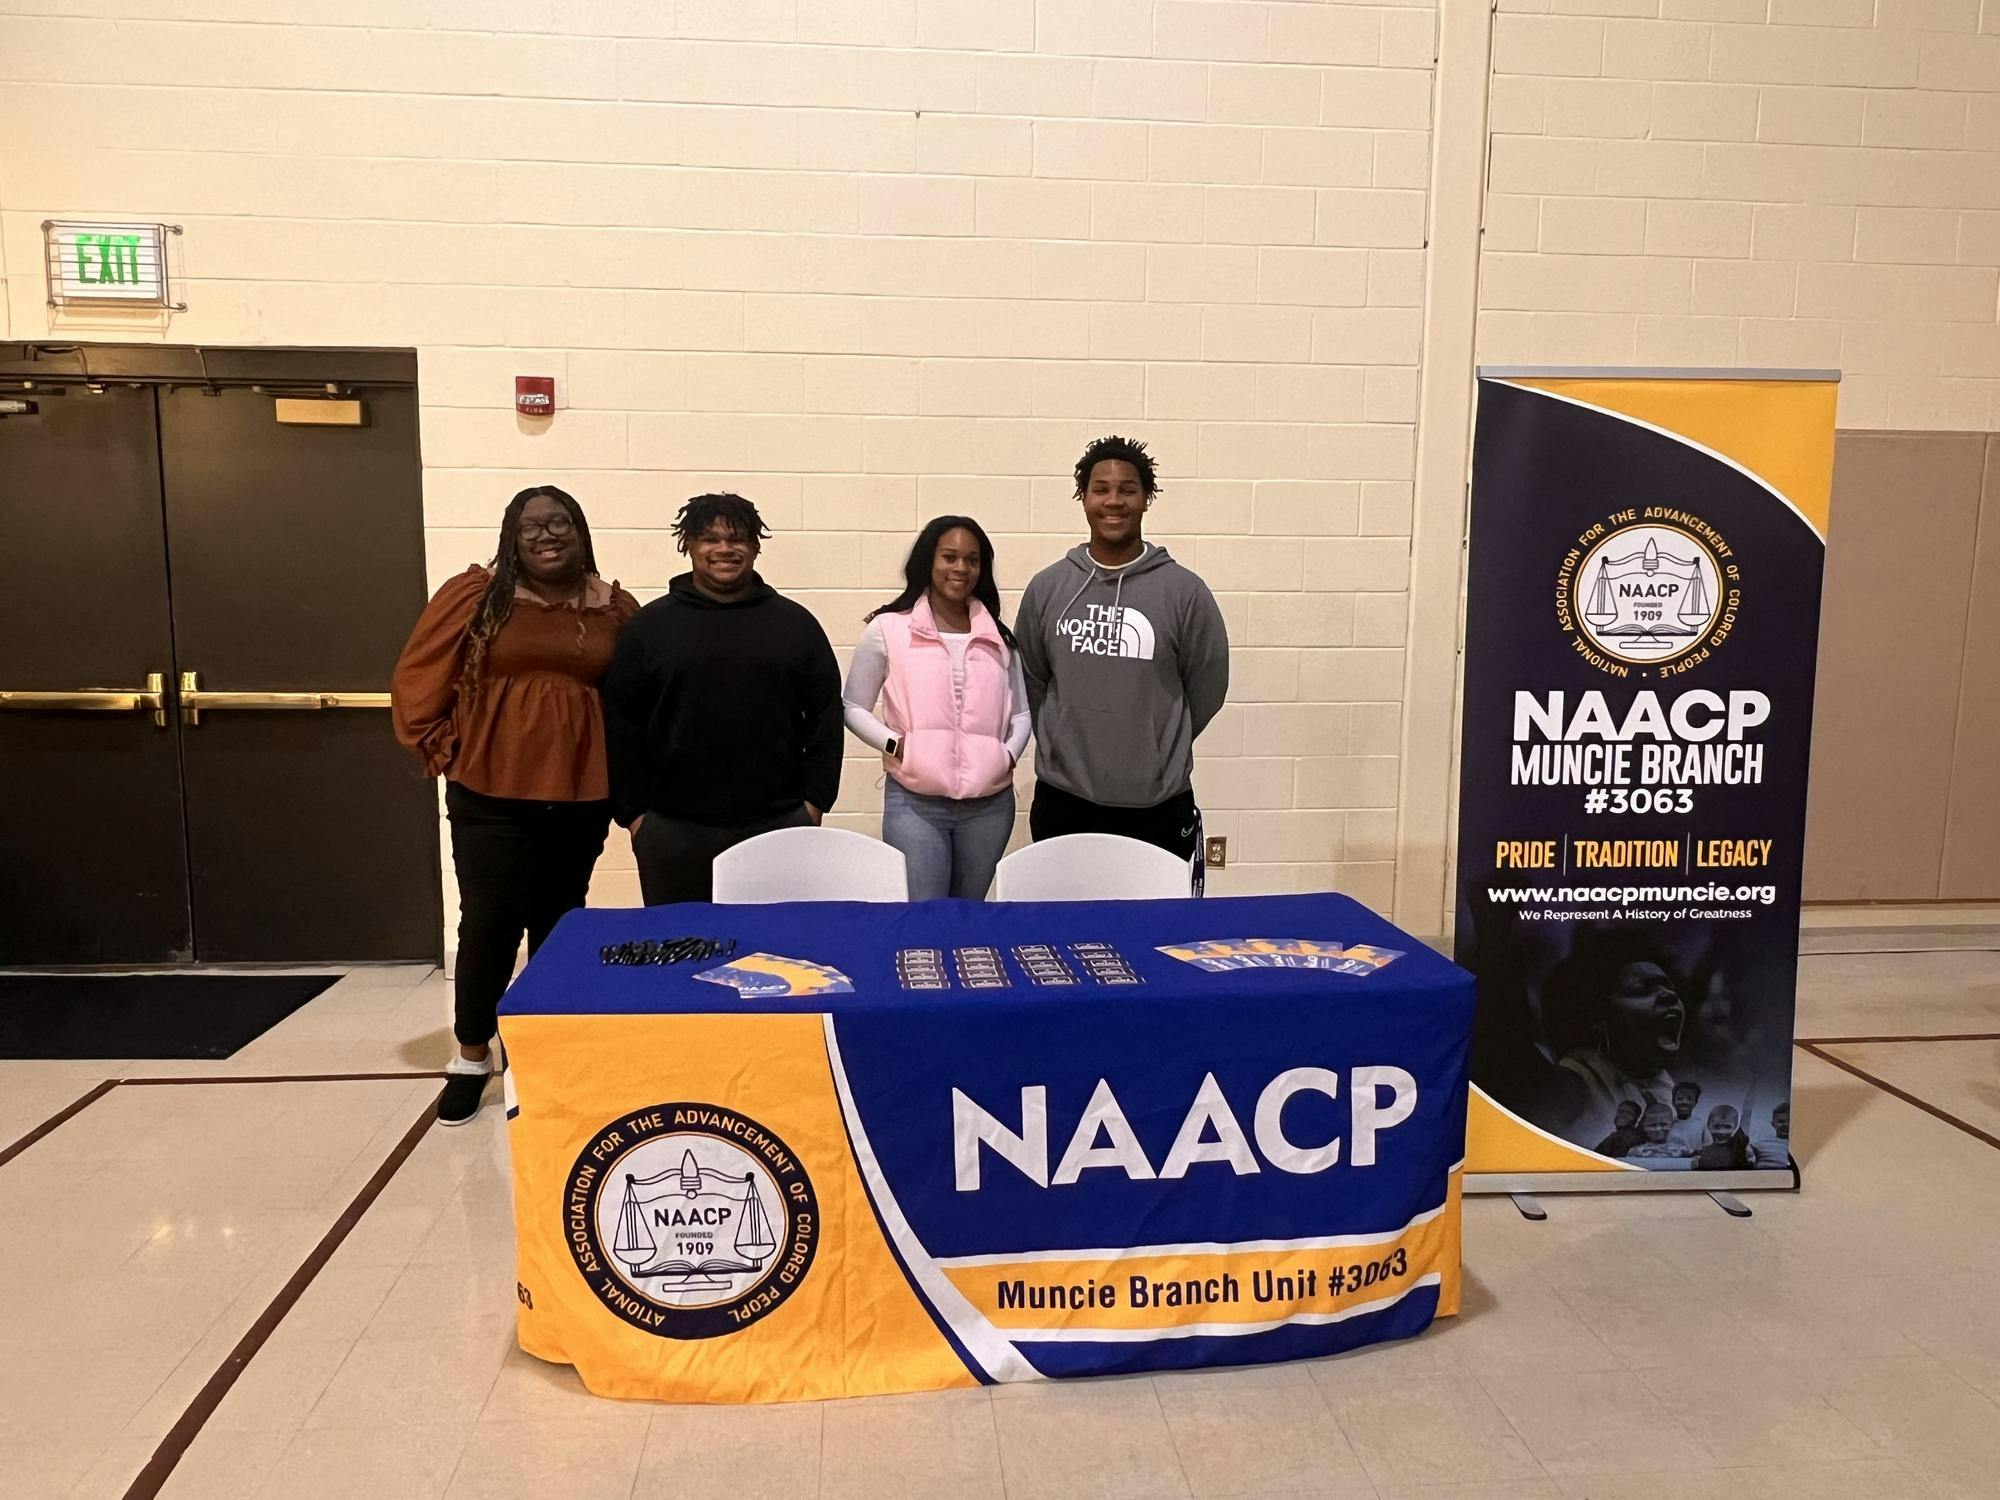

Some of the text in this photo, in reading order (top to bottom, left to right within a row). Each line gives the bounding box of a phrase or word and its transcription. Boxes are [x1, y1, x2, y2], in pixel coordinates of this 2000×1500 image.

[75, 234, 141, 284] EXIT
[1555, 506, 1741, 680] NATIONAL ASSOCIATION FOR THE ADVANCEMENT OF COLORED PEOPLE
[1618, 583, 1680, 598] NAACP
[1086, 603, 1123, 623] THE
[1633, 610, 1663, 621] 1909
[1056, 618, 1121, 640] NORTH
[1071, 635, 1119, 657] FACE
[1513, 689, 1771, 741] NAACP
[1511, 743, 1764, 786] MUNCIE BRANCH
[1583, 788, 1694, 814] #3063
[1495, 839, 1773, 869] PRIDE TRADITION LEGACY
[1487, 882, 1776, 906] www.naacpmuncie.org
[1518, 907, 1753, 922] We Represent A History of Greatness
[626, 1112, 665, 1135] THE
[951, 1065, 1419, 1193] NAACP
[592, 1131, 625, 1161] FOR
[673, 1110, 796, 1175] ADVANCEMENT
[789, 1181, 809, 1204] OF
[570, 1164, 600, 1273] ASSOCIATION
[654, 1207, 732, 1228] NAACP
[675, 1231, 714, 1239] FOUNDED
[676, 1241, 714, 1256] 1909
[780, 1212, 812, 1285] COLORED
[997, 1247, 1408, 1310] Muncie Branch Unit #3063
[727, 1285, 782, 1323] PEOPL
